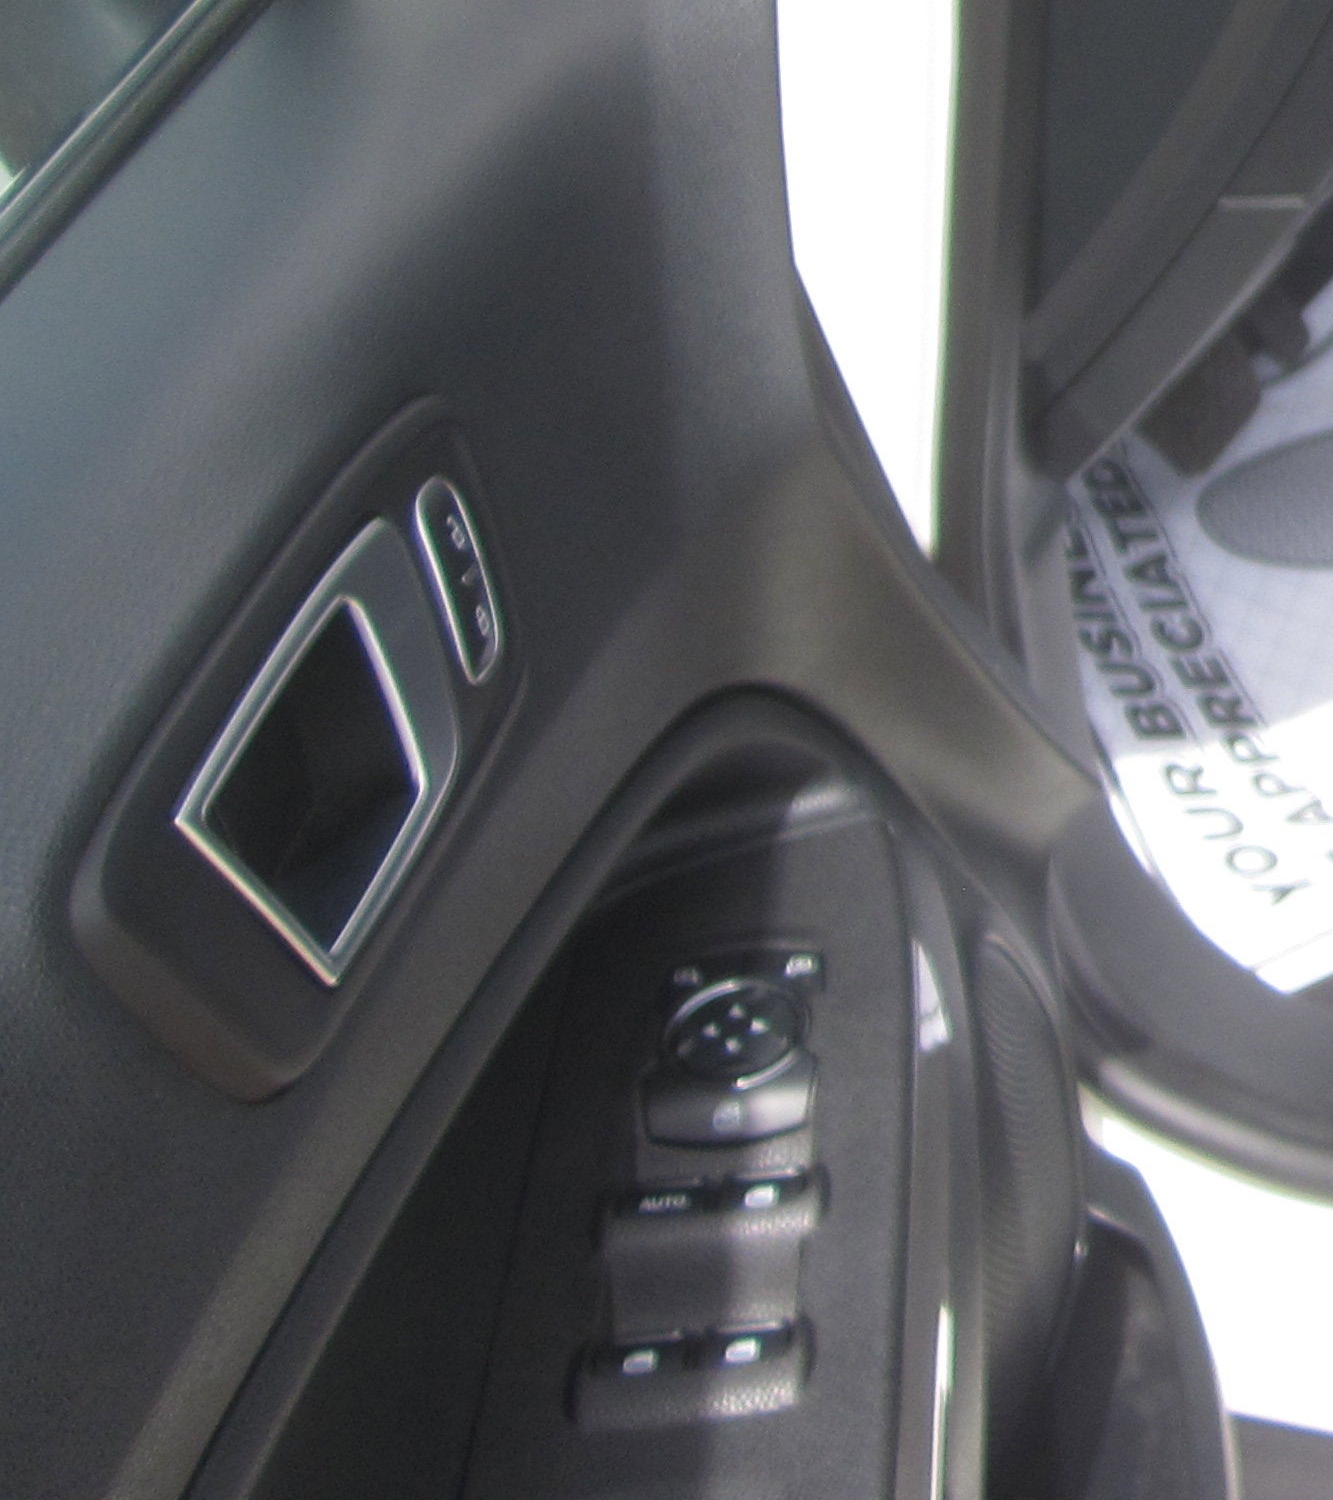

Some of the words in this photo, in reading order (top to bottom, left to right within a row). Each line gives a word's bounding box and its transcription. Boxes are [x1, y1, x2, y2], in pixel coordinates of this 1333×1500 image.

[1064, 522, 1188, 741] BUSINE
[1161, 760, 1311, 906] YOUR
[637, 1193, 688, 1212] AUTO
